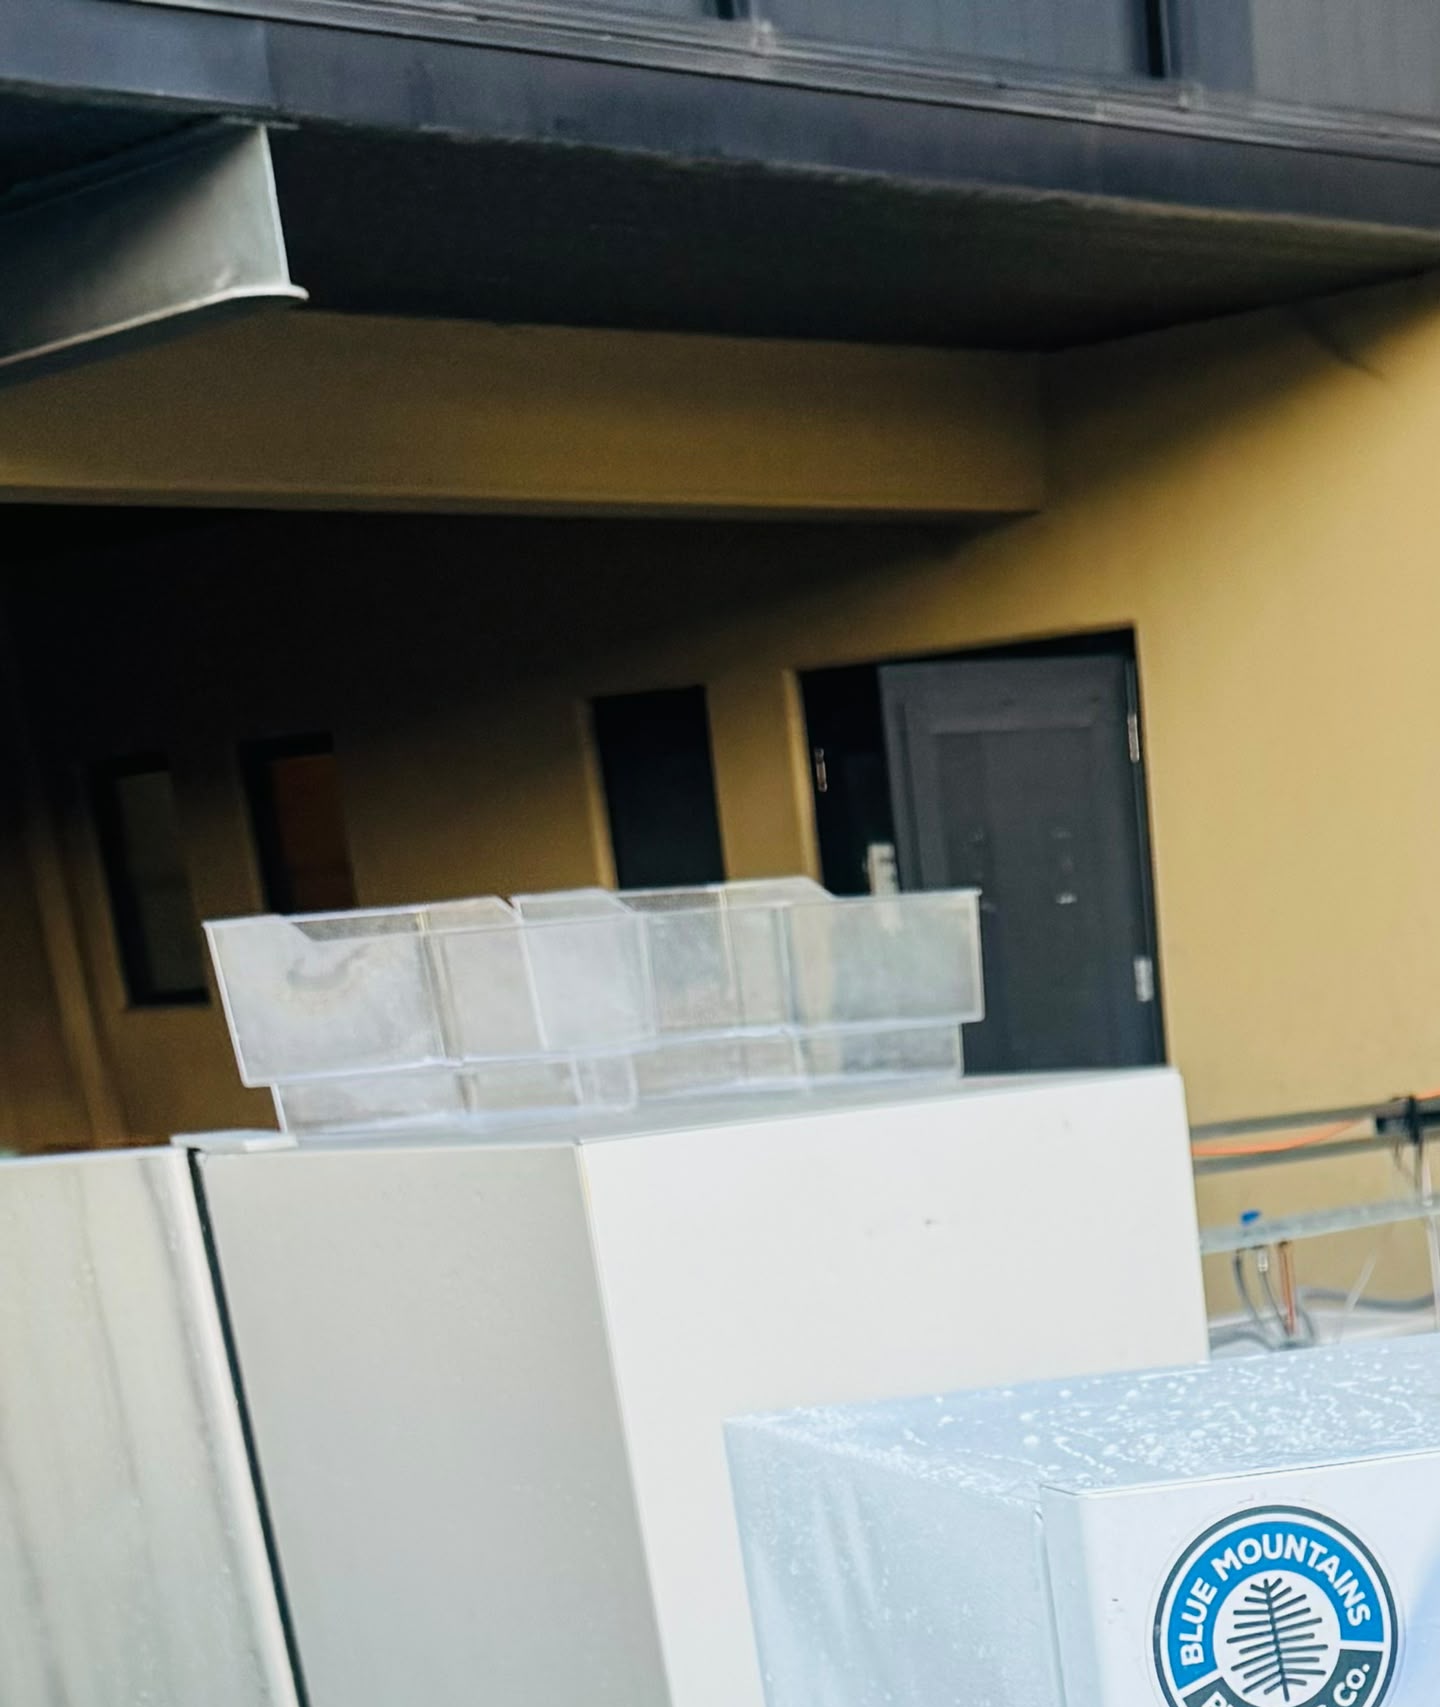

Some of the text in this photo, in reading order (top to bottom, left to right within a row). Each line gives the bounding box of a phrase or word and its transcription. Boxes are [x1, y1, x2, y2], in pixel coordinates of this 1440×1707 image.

[1179, 1533, 1371, 1666] BLUE MOUNTAINS
[1333, 1664, 1370, 1707] CO.
